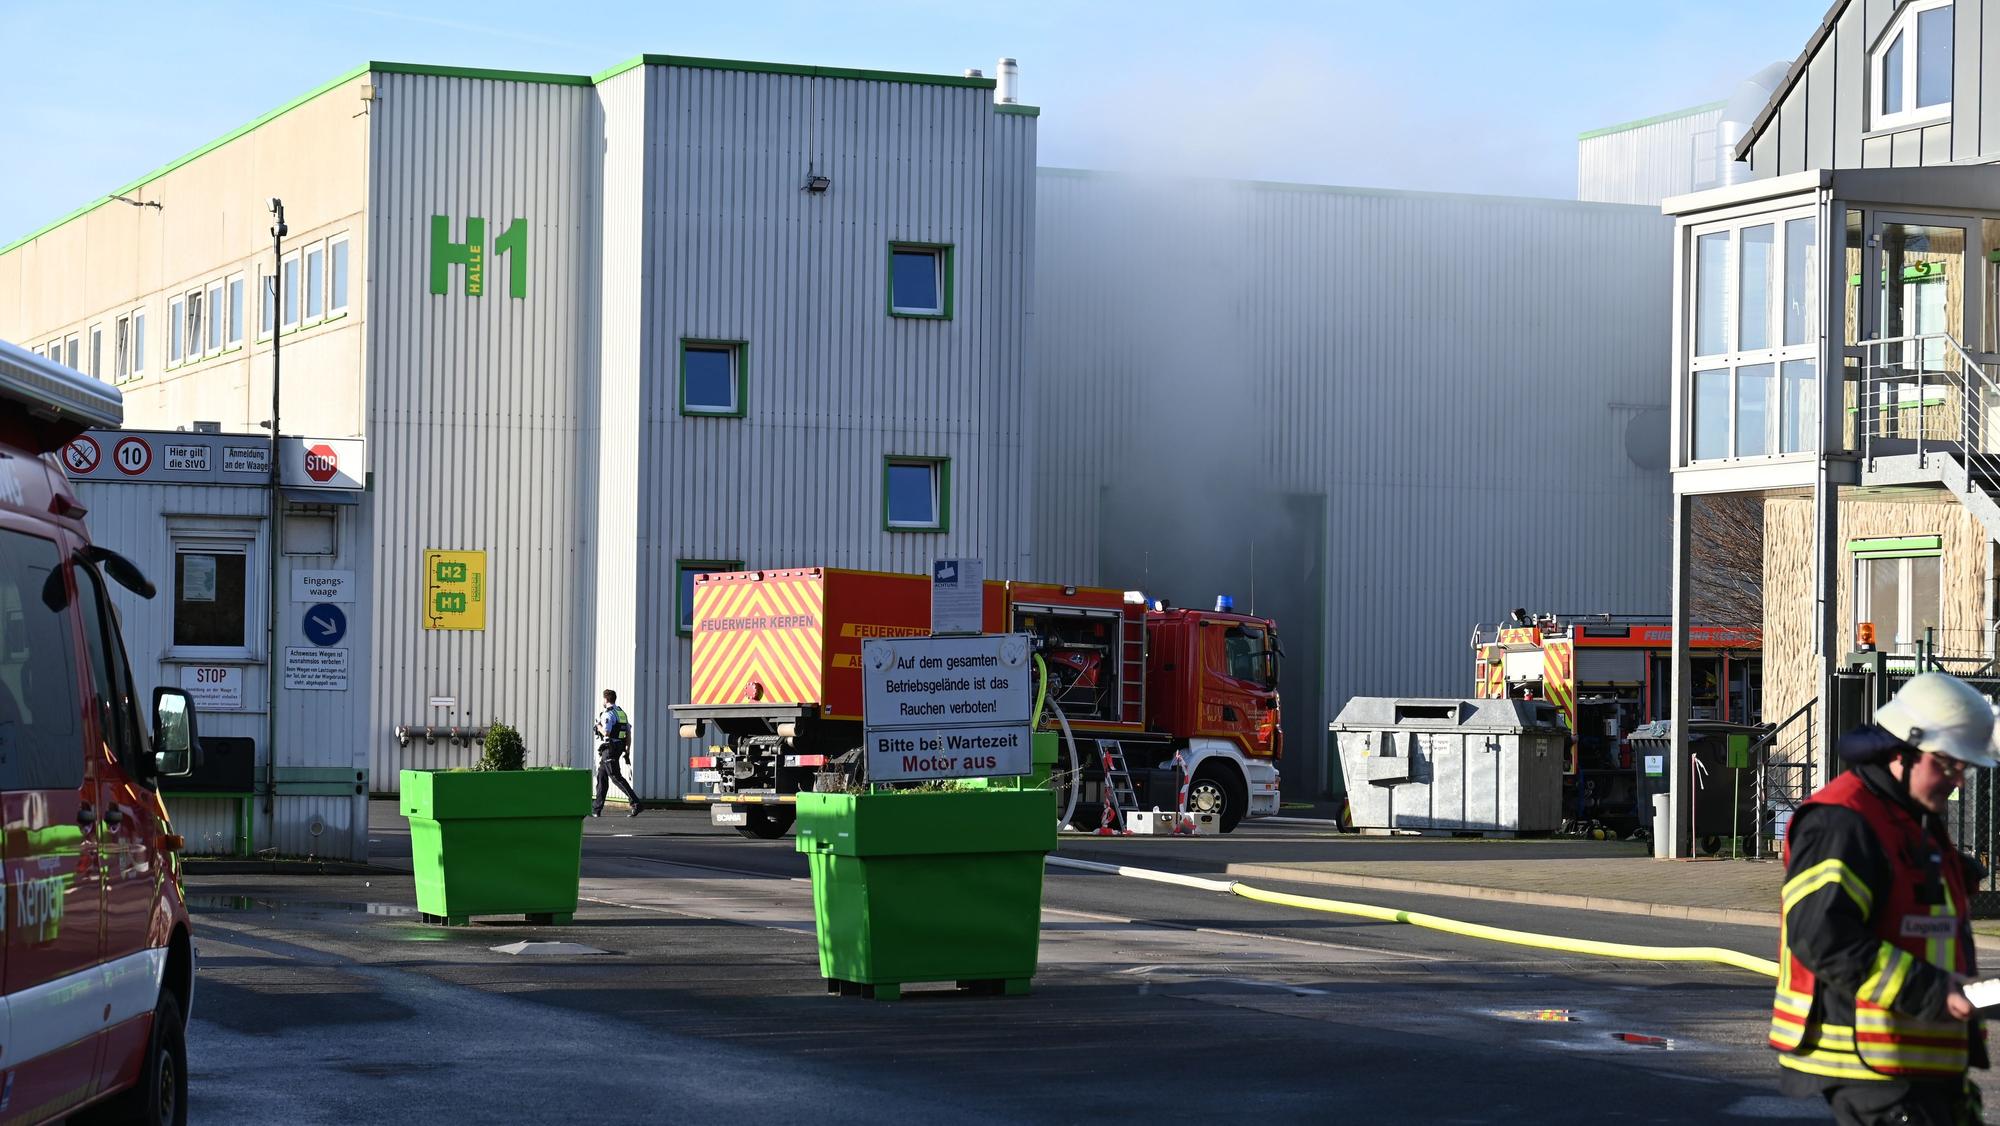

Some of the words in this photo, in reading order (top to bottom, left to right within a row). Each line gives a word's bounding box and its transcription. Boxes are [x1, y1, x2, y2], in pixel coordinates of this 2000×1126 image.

[429, 215, 528, 299] H1
[469, 245, 481, 293] HALLE
[122, 447, 142, 465] 10
[169, 447, 187, 457] Hier
[189, 448, 203, 459] gilt
[229, 449, 265, 461] Anmeldung
[169, 459, 183, 468] die
[185, 459, 206, 469] StVO
[234, 460, 245, 470] der
[246, 461, 269, 471] Waage
[307, 455, 336, 471] STOP
[441, 566, 461, 578] H2
[303, 576, 344, 587] Eingangs-
[310, 589, 337, 598] waage
[441, 597, 460, 609] H1
[701, 617, 767, 631] FEUERWEHR
[770, 615, 814, 628] KERPEN
[897, 656, 915, 669] Auf
[919, 655, 942, 668] dem
[947, 654, 998, 670] gesamten
[197, 668, 227, 683] STOP
[886, 677, 970, 694] Betriebsgelände
[973, 677, 986, 690] ist
[990, 676, 1009, 689] das
[900, 701, 945, 716] Rauchen
[950, 700, 997, 714] verboten!
[878, 738, 914, 752] Bitte
[919, 736, 942, 751] bei
[947, 733, 1018, 750] Wartezeit
[902, 755, 958, 772] Motor
[963, 755, 997, 769] aus
[15, 867, 65, 942] Kerpen
